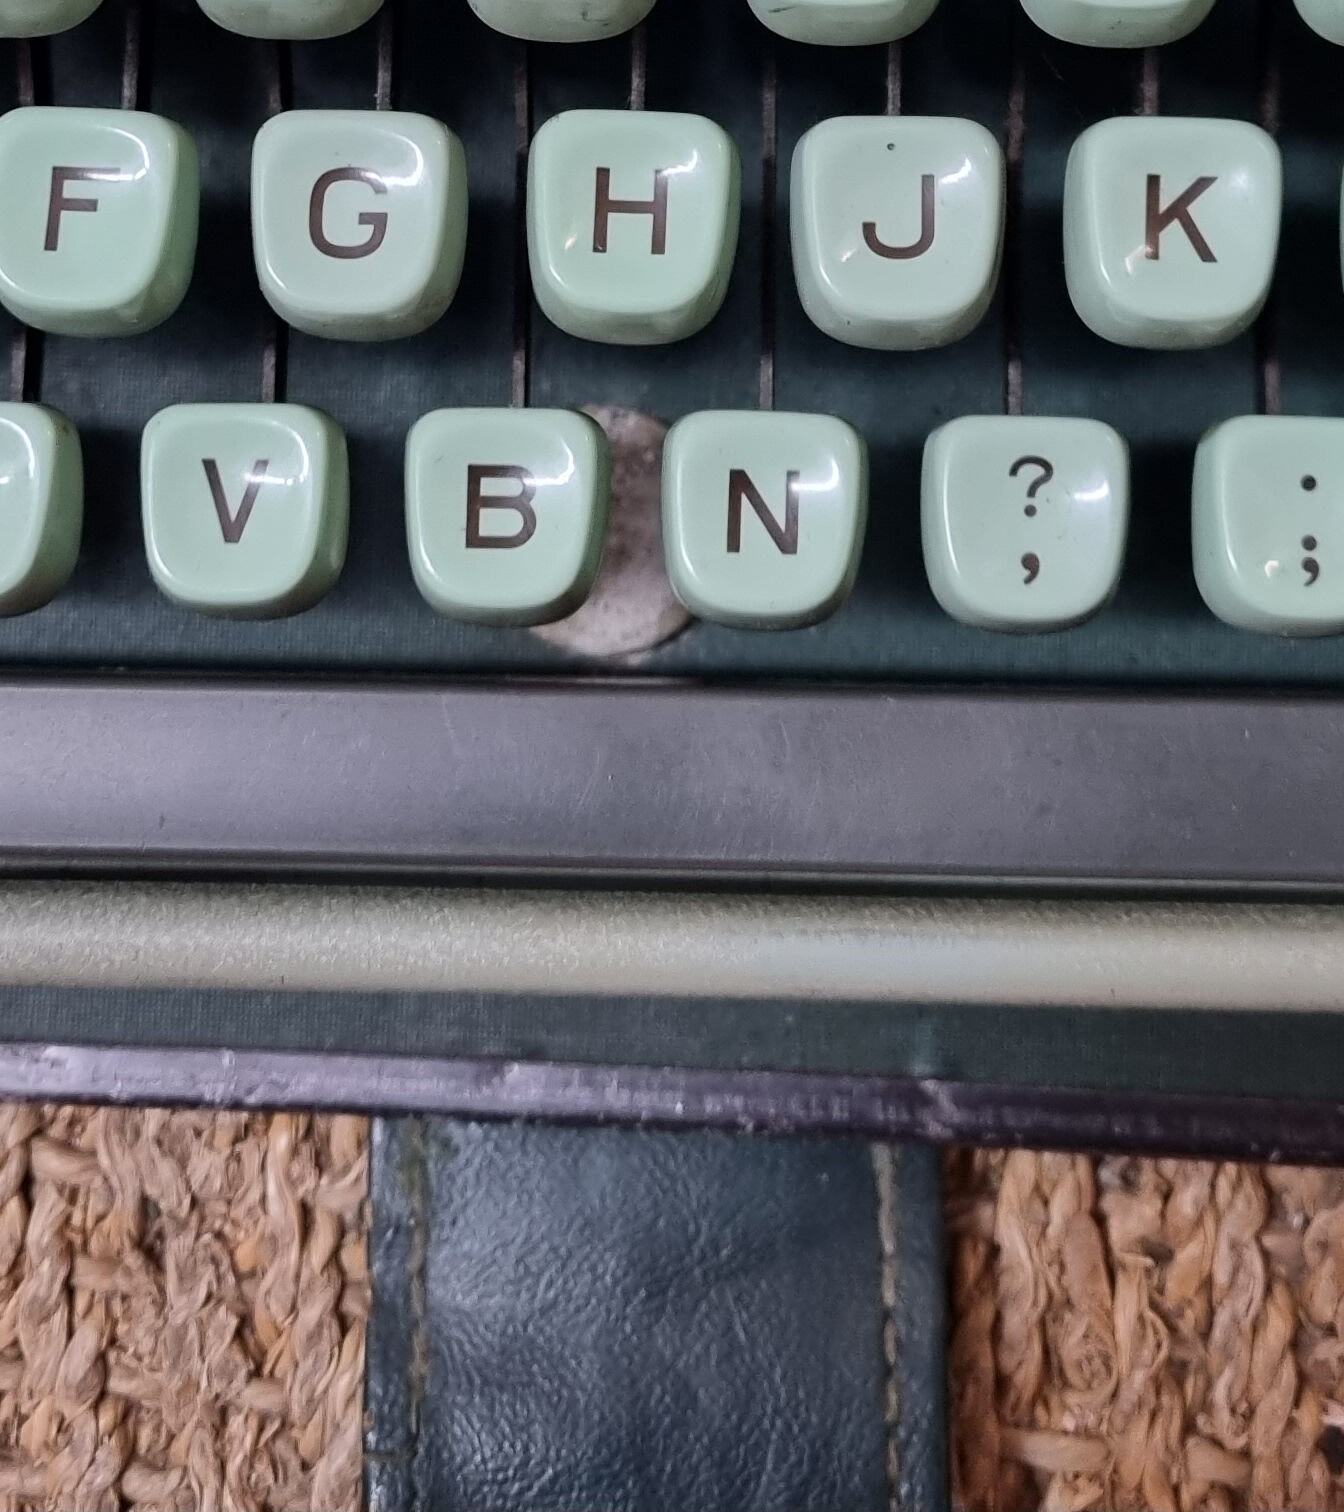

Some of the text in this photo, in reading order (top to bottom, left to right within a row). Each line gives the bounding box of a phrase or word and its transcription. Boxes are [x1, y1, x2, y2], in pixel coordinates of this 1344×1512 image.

[44, 166, 121, 252] F
[308, 166, 388, 260] G
[592, 166, 668, 255] H
[861, 174, 935, 260] J
[1145, 173, 1218, 263] K
[201, 457, 270, 545] V
[465, 463, 537, 549] B
[726, 468, 799, 555] N
[1008, 454, 1055, 519] ?
[1301, 535, 1320, 587] ;
